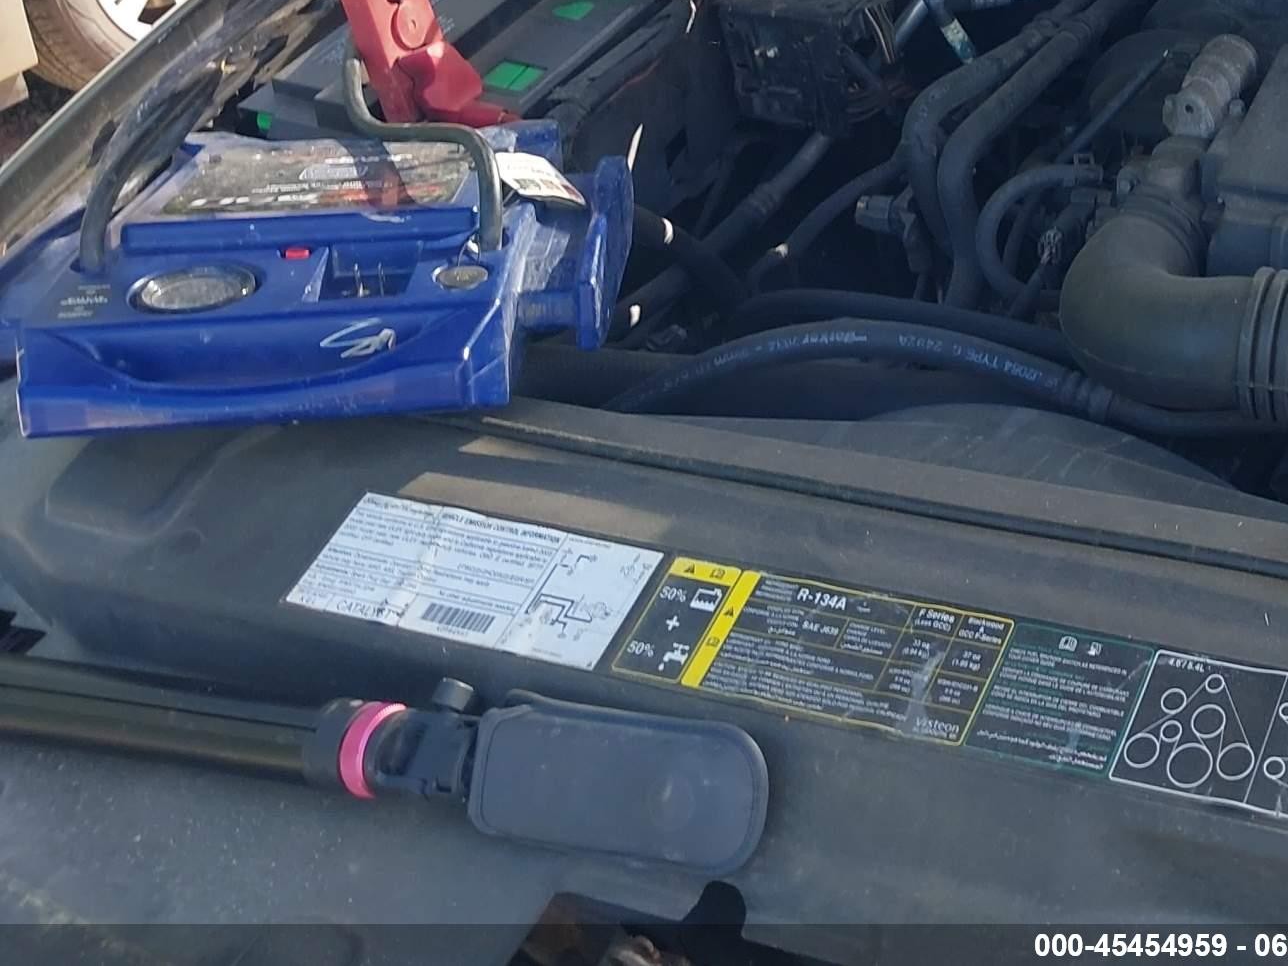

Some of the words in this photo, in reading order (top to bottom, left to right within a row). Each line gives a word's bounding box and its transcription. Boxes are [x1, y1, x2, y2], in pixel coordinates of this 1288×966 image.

[659, 585, 687, 603] 50%
[797, 587, 847, 611] R-134A
[927, 609, 955, 624] Series
[802, 620, 819, 633] SAE
[626, 639, 654, 658] 50%
